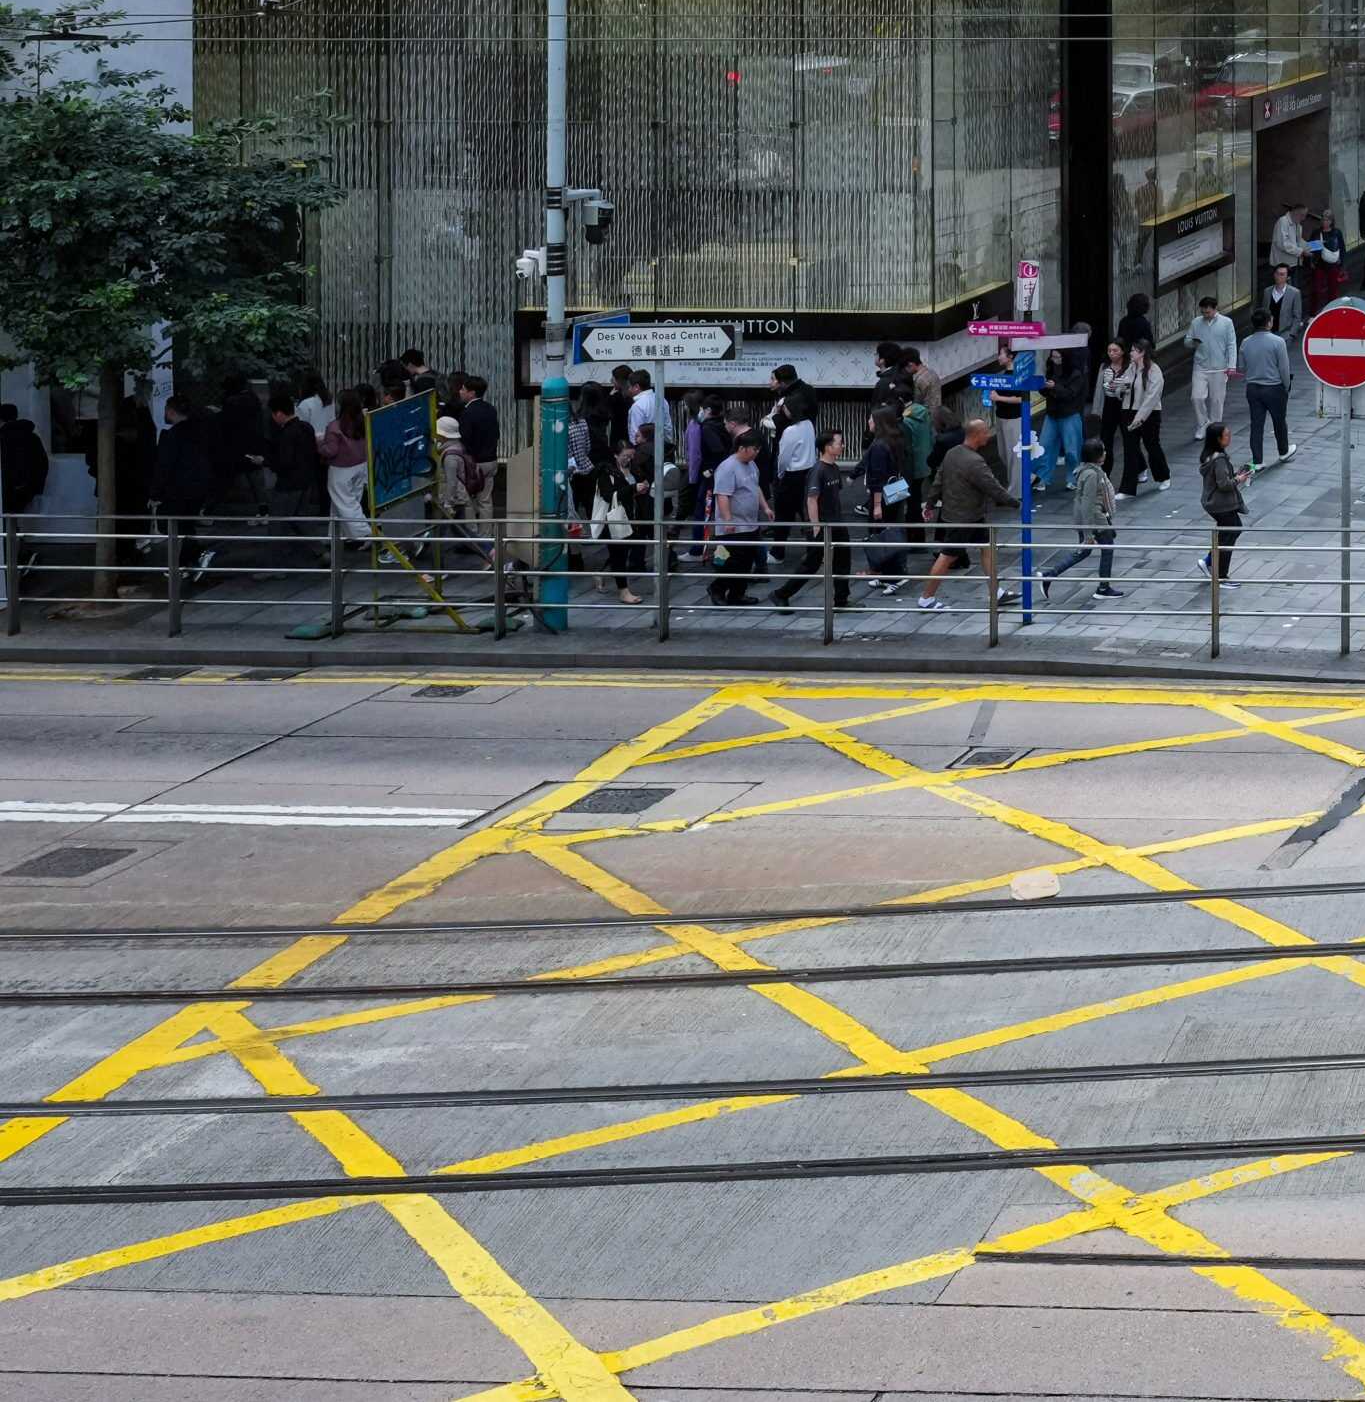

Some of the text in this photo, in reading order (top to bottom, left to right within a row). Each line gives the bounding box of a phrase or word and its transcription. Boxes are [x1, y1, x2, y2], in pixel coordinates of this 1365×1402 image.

[1177, 206, 1218, 235] LOUIS VUITTON
[597, 330, 716, 341] Des Voeux Road Central
